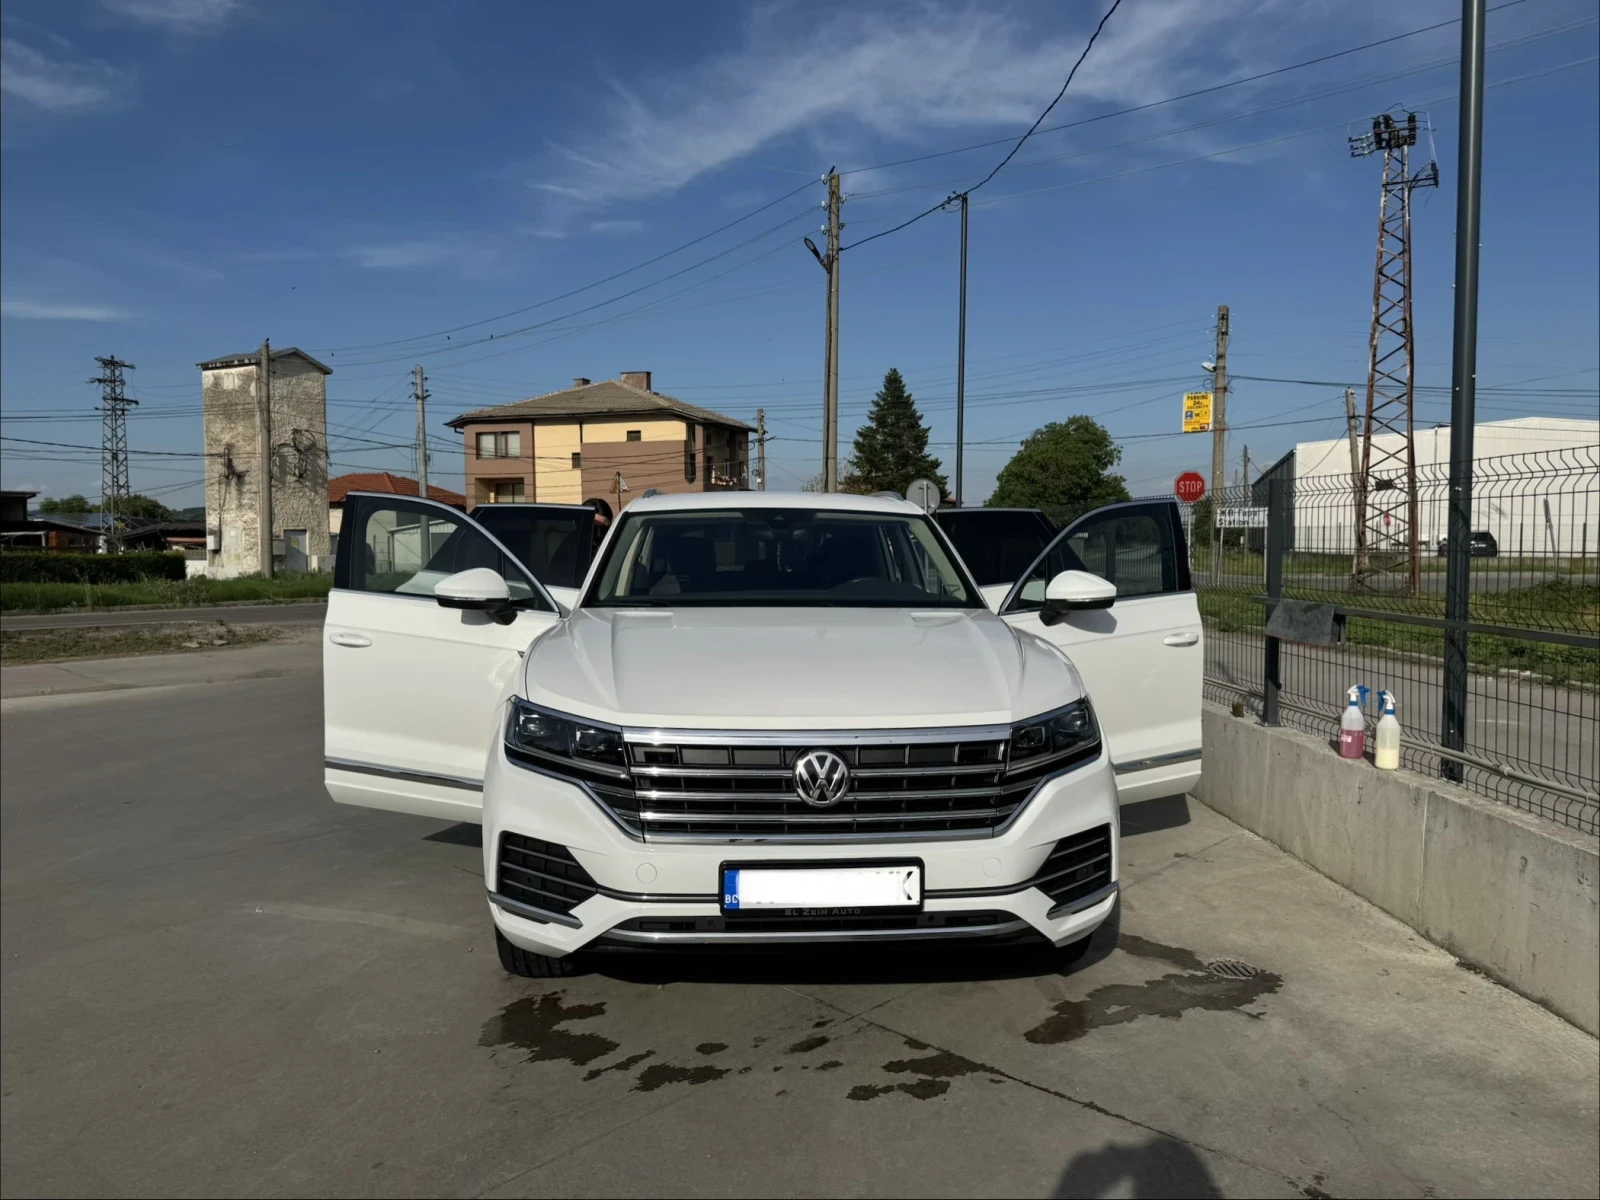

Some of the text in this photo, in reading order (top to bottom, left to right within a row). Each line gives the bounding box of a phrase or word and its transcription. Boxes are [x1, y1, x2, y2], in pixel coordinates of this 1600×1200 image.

[1179, 481, 1203, 493] STOP
[1218, 518, 1249, 526] Station
[796, 752, 848, 804] VW
[784, 907, 861, 916] EL ZEIN AUTO
